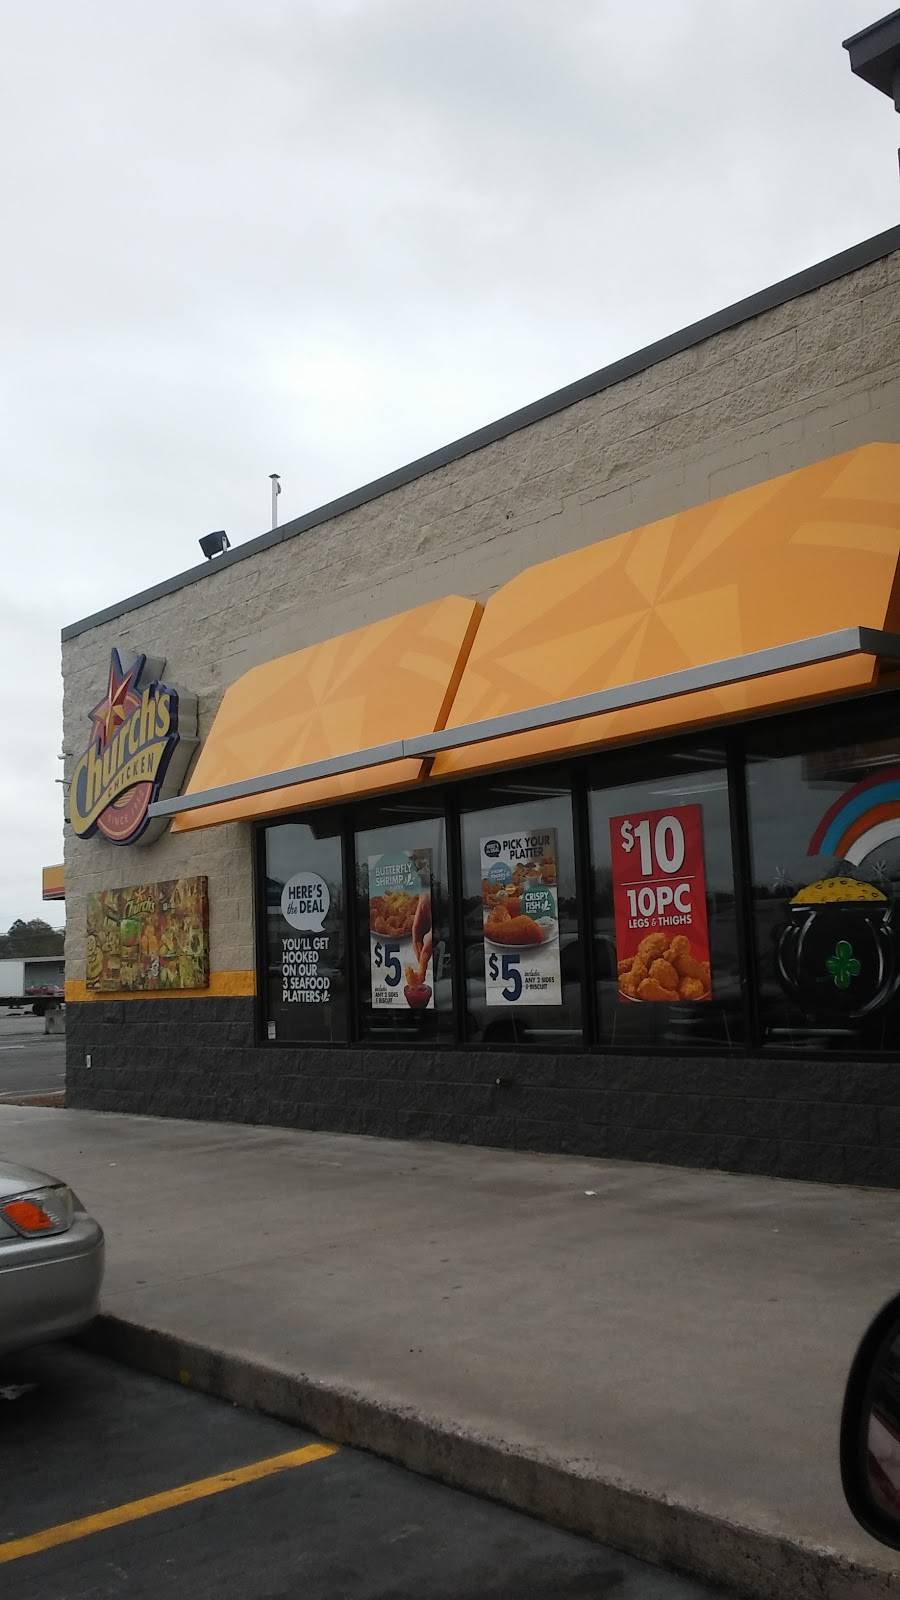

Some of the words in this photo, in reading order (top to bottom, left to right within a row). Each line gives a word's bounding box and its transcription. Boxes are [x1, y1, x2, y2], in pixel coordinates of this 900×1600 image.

[70, 688, 171, 834] Church's
[107, 752, 155, 798] CHICKEN
[503, 839, 522, 851] PICK
[525, 834, 550, 847] YOUR
[621, 815, 685, 876] $10
[509, 847, 544, 860] PLATTER
[375, 863, 413, 876] BUTTERFLY
[375, 874, 404, 887] SHRIMP
[288, 883, 323, 900] HERE'S
[525, 891, 549, 901] CRISPY
[525, 900, 541, 911] FISH
[627, 883, 692, 917] 10PC
[287, 902, 298, 915] the
[299, 900, 325, 914] DEAL
[628, 917, 650, 929] LEGS
[651, 918, 657, 927] &
[658, 914, 692, 926] THIGHS
[282, 937, 311, 951] YOU'LL
[312, 937, 330, 950] GET
[282, 951, 319, 964] HOOKED
[374, 942, 402, 987] $5
[282, 964, 298, 977] ON
[298, 964, 318, 977] OUR
[488, 953, 523, 1002] $5
[282, 977, 288, 990] 3
[290, 976, 330, 990] SEAFOOD
[282, 989, 321, 1003] PLATTERS
